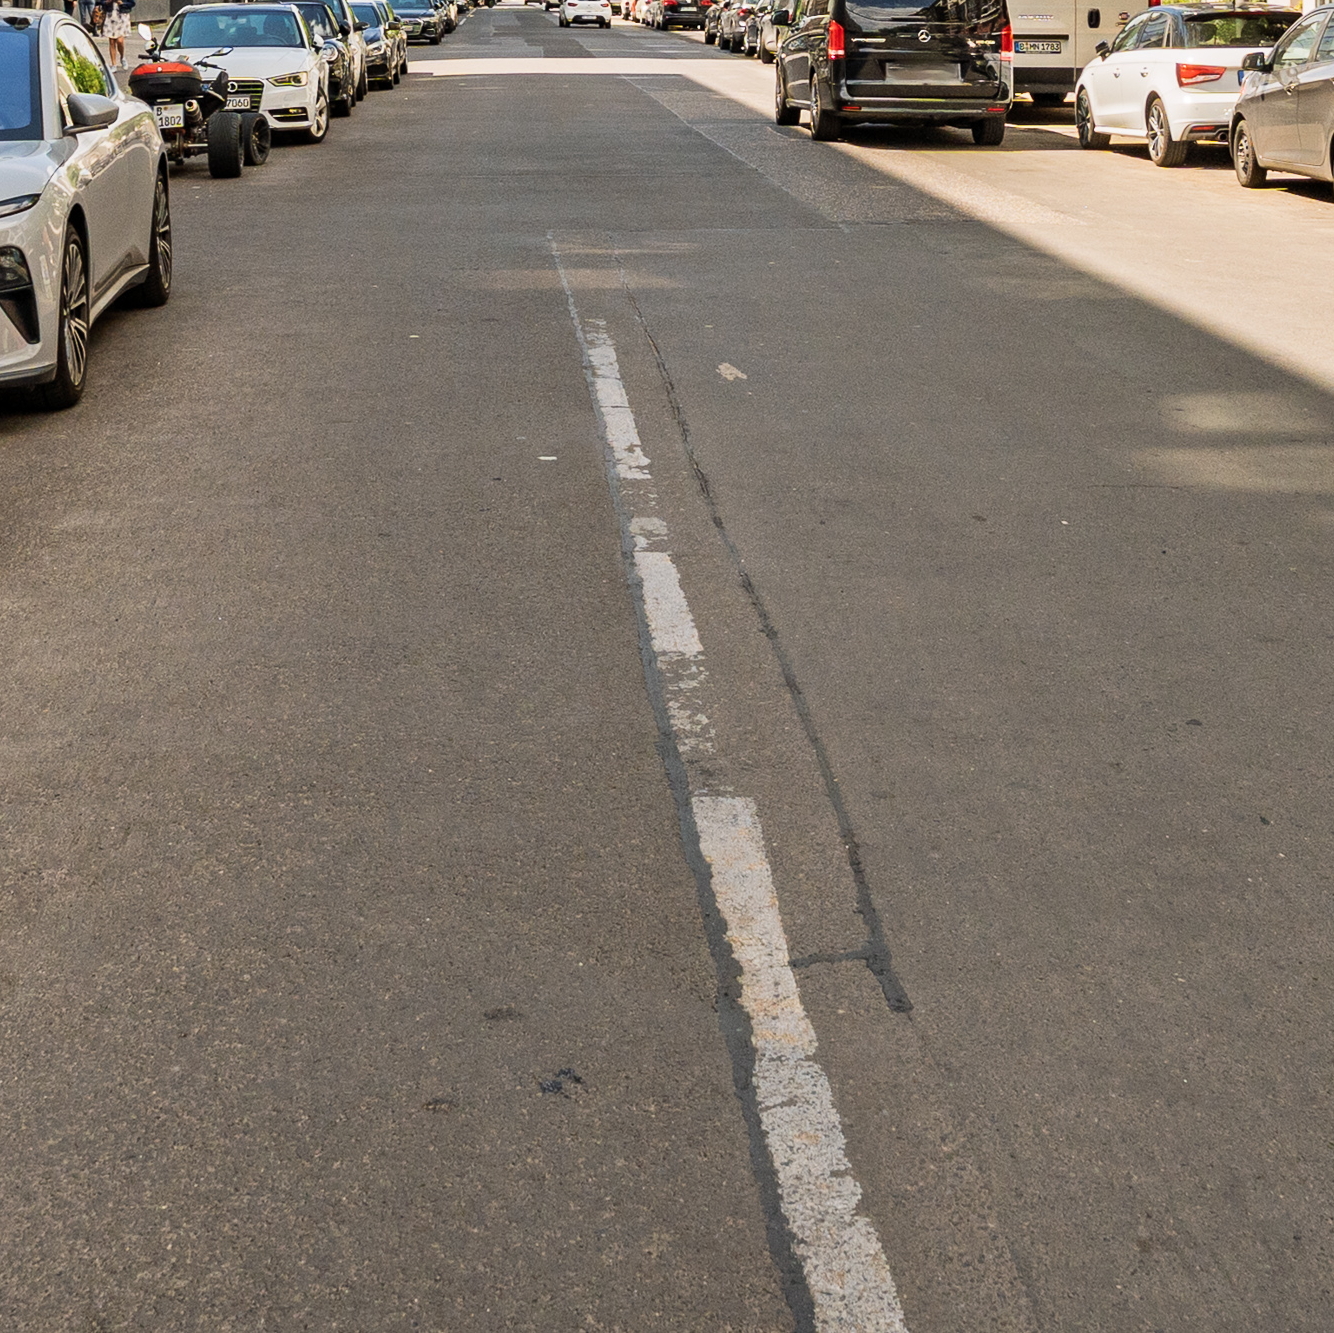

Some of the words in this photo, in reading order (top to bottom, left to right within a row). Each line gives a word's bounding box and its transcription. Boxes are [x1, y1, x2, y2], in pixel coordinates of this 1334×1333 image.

[227, 99, 250, 108] 7060
[156, 107, 163, 116] B
[158, 116, 182, 127] 1802
